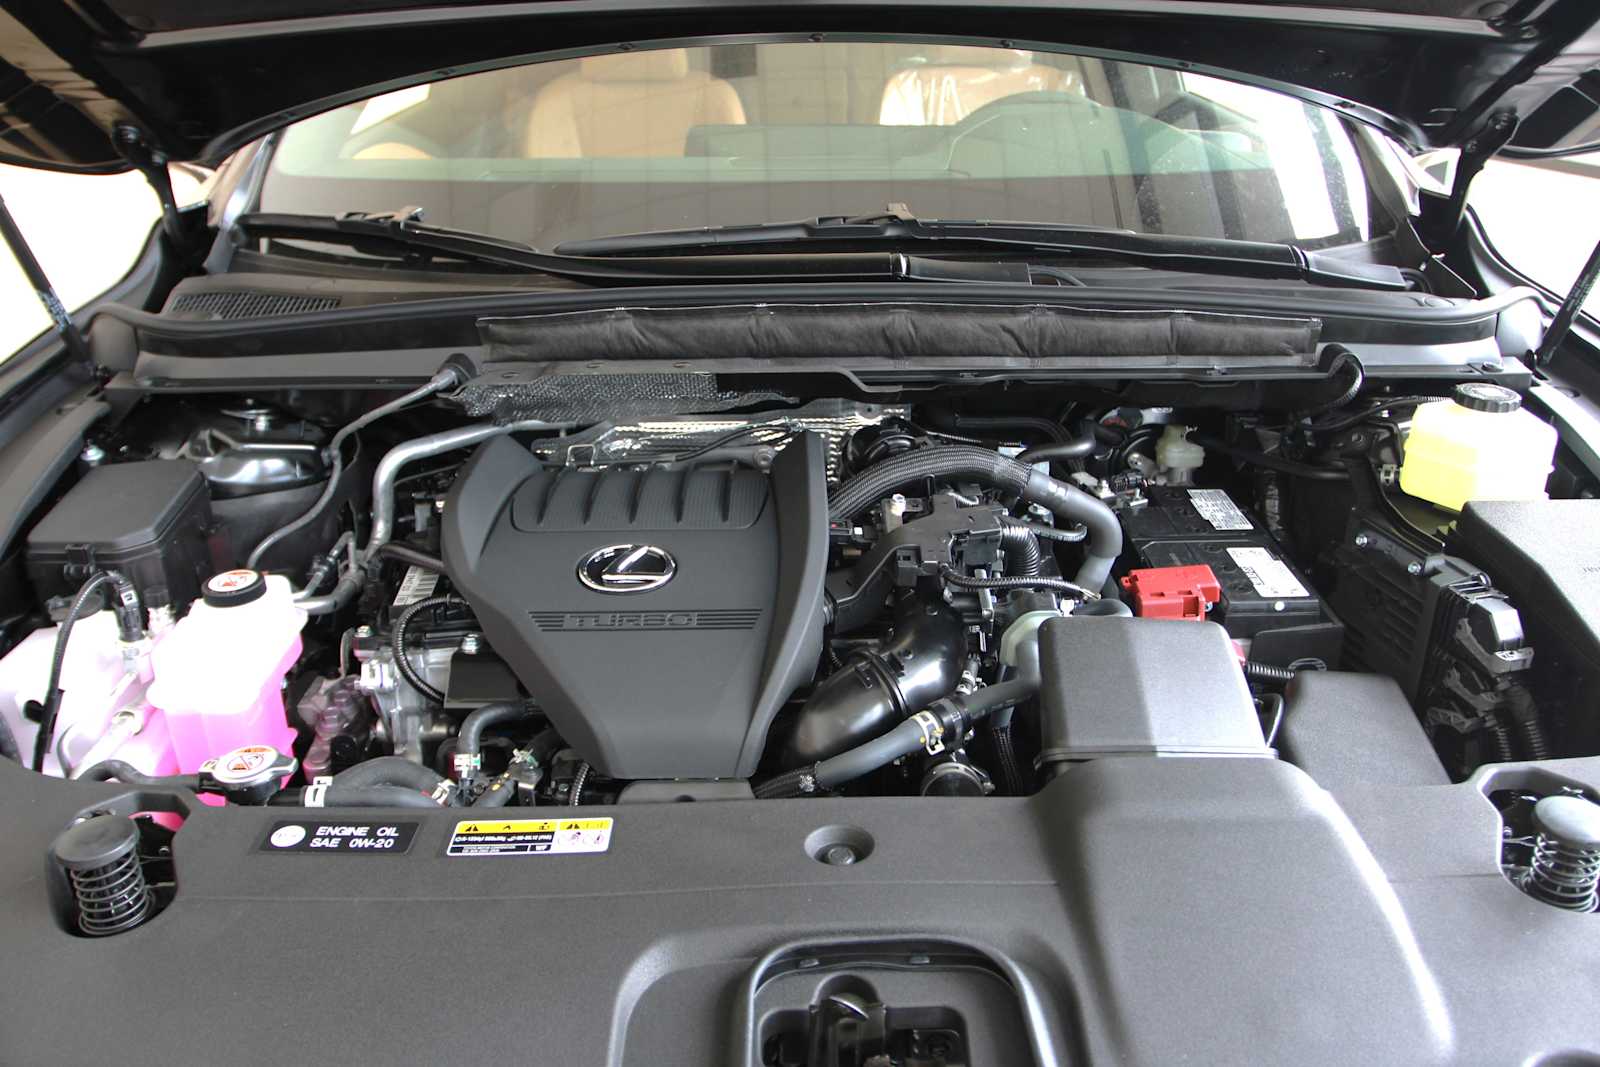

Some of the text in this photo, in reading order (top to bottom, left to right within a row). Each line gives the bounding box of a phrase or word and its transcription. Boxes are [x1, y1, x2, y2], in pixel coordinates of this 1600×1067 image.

[567, 613, 695, 628] TURBO
[315, 826, 400, 837] ENGINE OIL
[309, 837, 395, 848] SAE 0W-20
